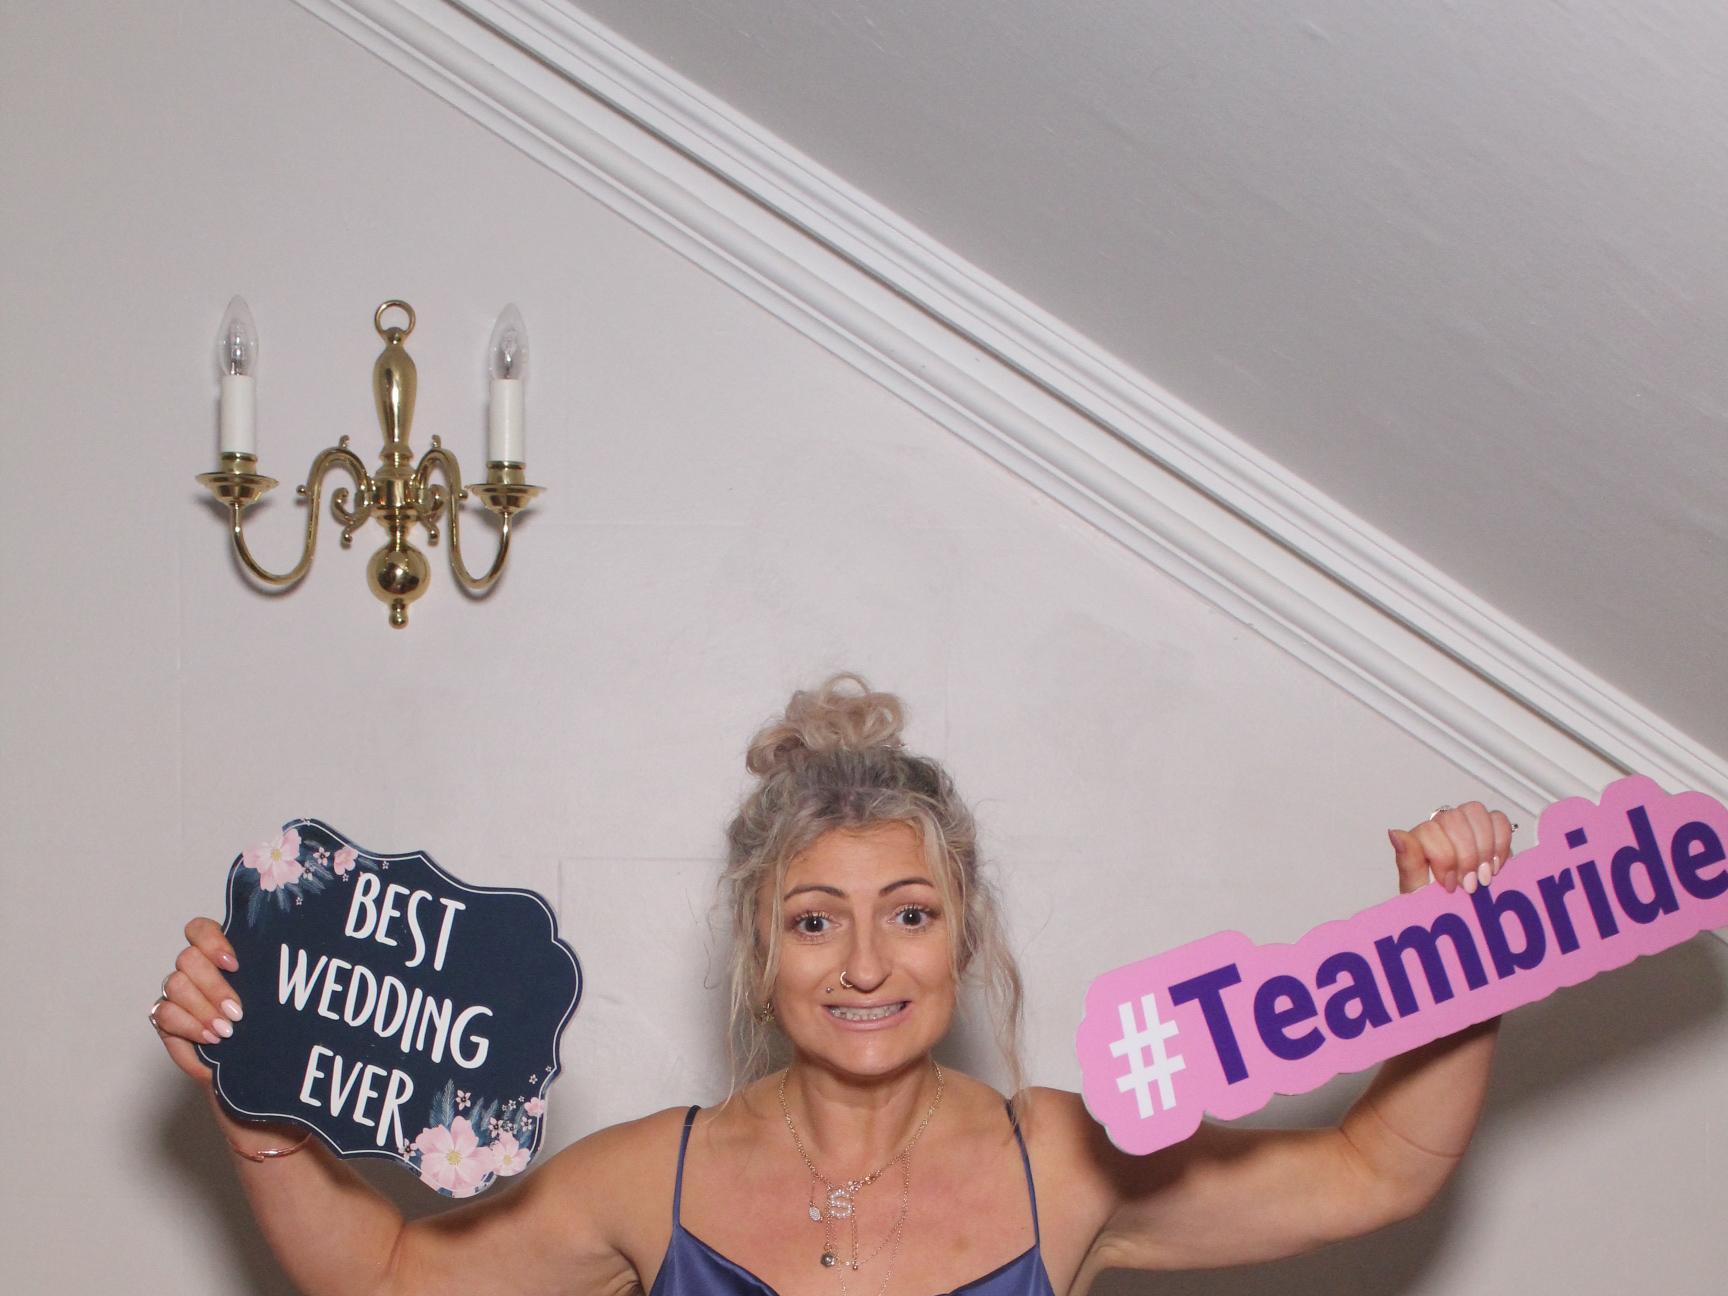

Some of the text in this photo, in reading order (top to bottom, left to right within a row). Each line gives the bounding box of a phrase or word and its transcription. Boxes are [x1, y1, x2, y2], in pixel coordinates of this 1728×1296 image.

[345, 872, 466, 971] BEST
[1109, 805, 1728, 1119] #Teambride
[278, 943, 493, 1069] WEDDING
[300, 1045, 414, 1149] EVER
